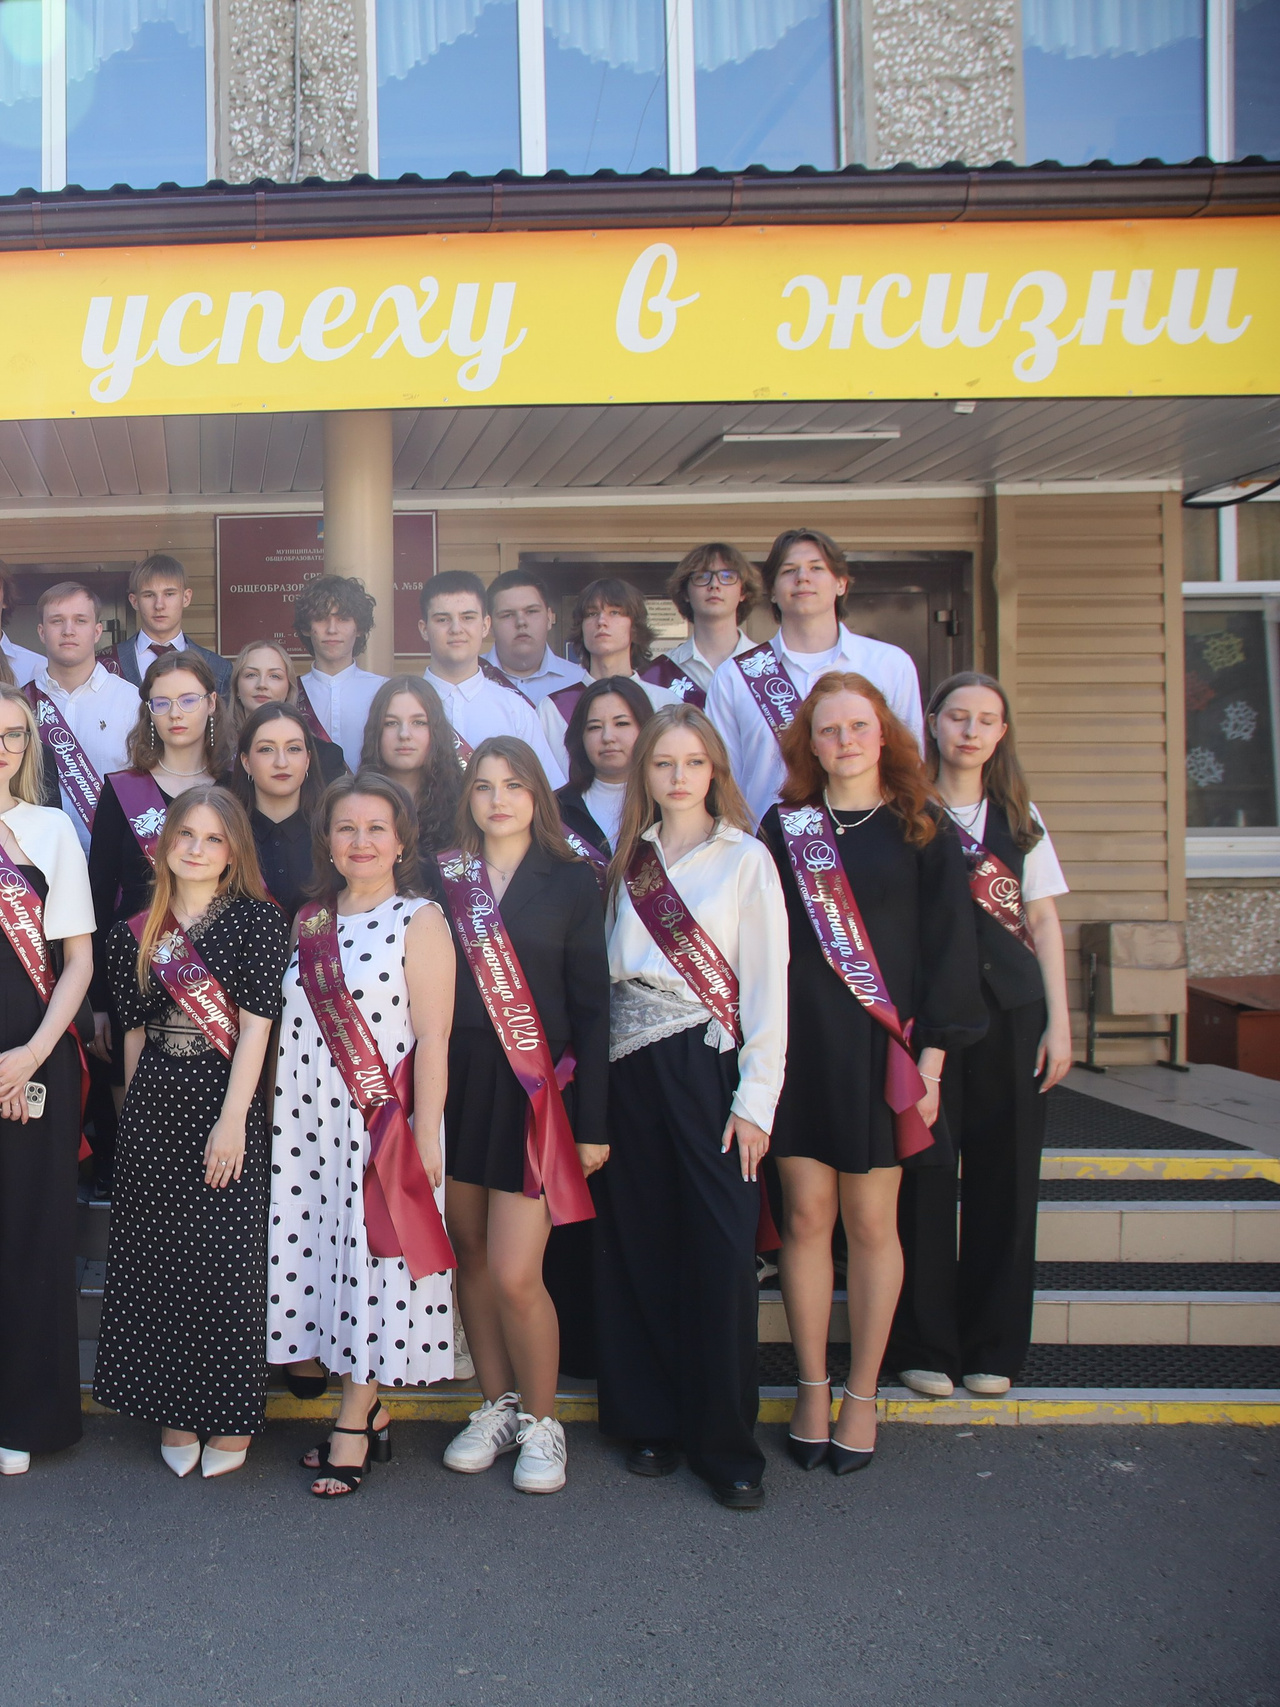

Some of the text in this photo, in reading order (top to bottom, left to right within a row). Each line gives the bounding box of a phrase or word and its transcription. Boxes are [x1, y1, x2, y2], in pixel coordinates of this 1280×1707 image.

[81, 276, 527, 403] успеху
[615, 242, 701, 353] в
[777, 266, 1252, 383] жизни
[462, 888, 542, 1051] Выпускница 2026
[499, 951, 522, 989] Анастасия
[653, 894, 731, 999] Выпускница
[803, 842, 886, 1007] Выпускница 2026
[319, 998, 361, 1065] руководитель
[353, 1064, 394, 1107] 2026
